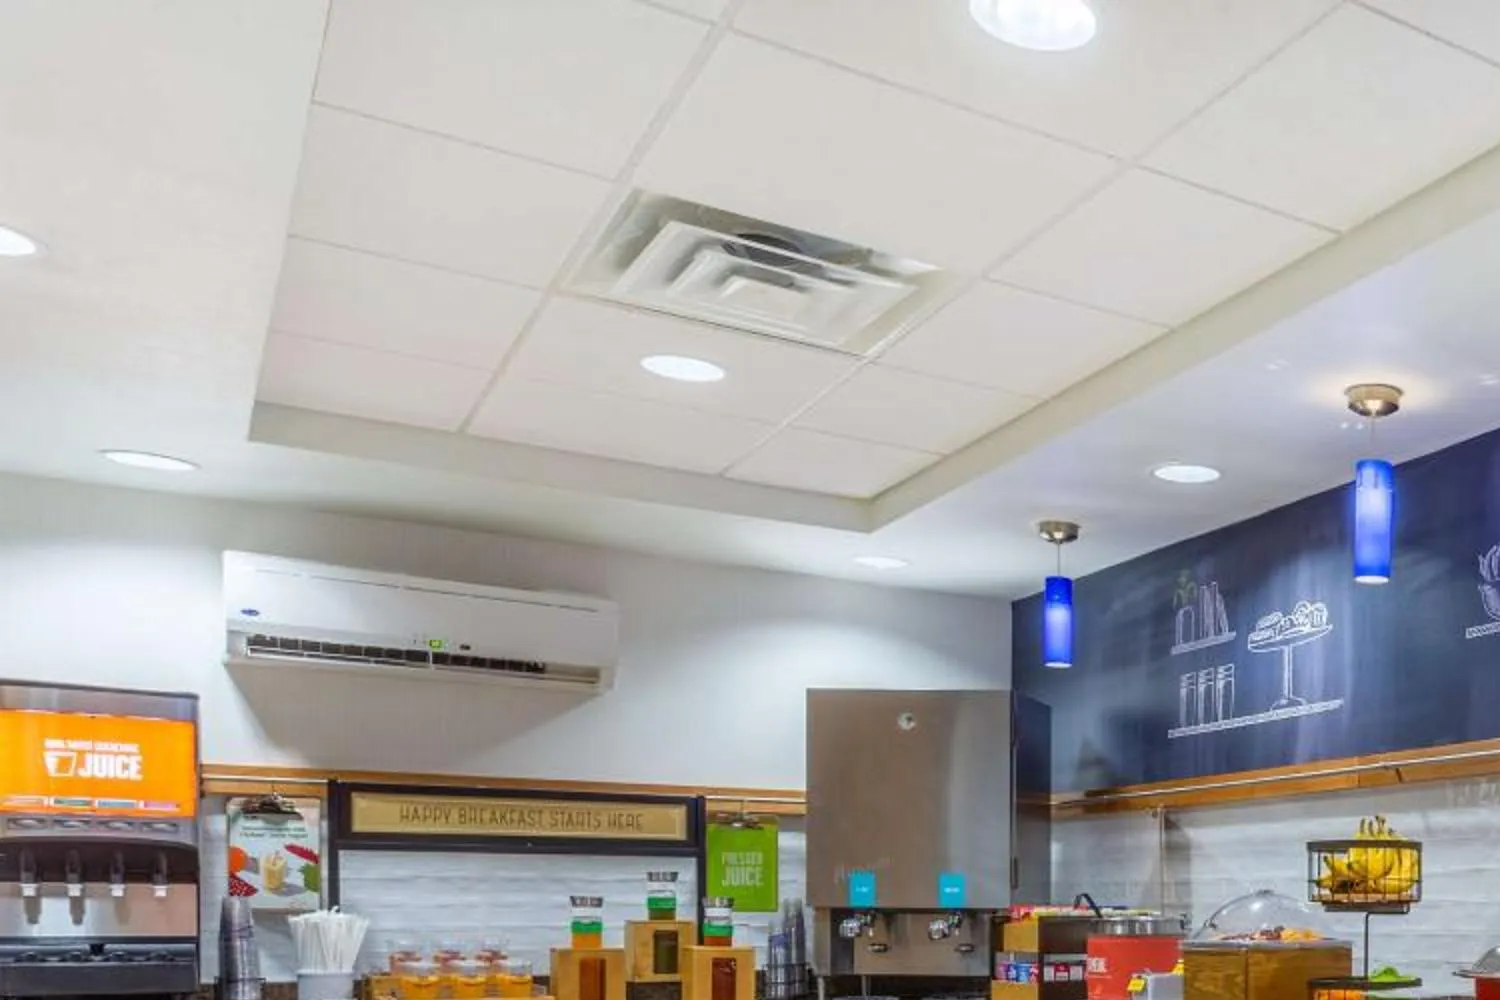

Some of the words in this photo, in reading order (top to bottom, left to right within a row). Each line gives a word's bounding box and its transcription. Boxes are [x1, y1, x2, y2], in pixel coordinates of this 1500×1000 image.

[77, 752, 143, 781] JUICE
[400, 804, 452, 825] HAPPY
[459, 806, 544, 829] BREAKFAST
[549, 809, 601, 831] STARTS
[607, 811, 644, 832] HERE
[721, 866, 765, 887] JUICE
